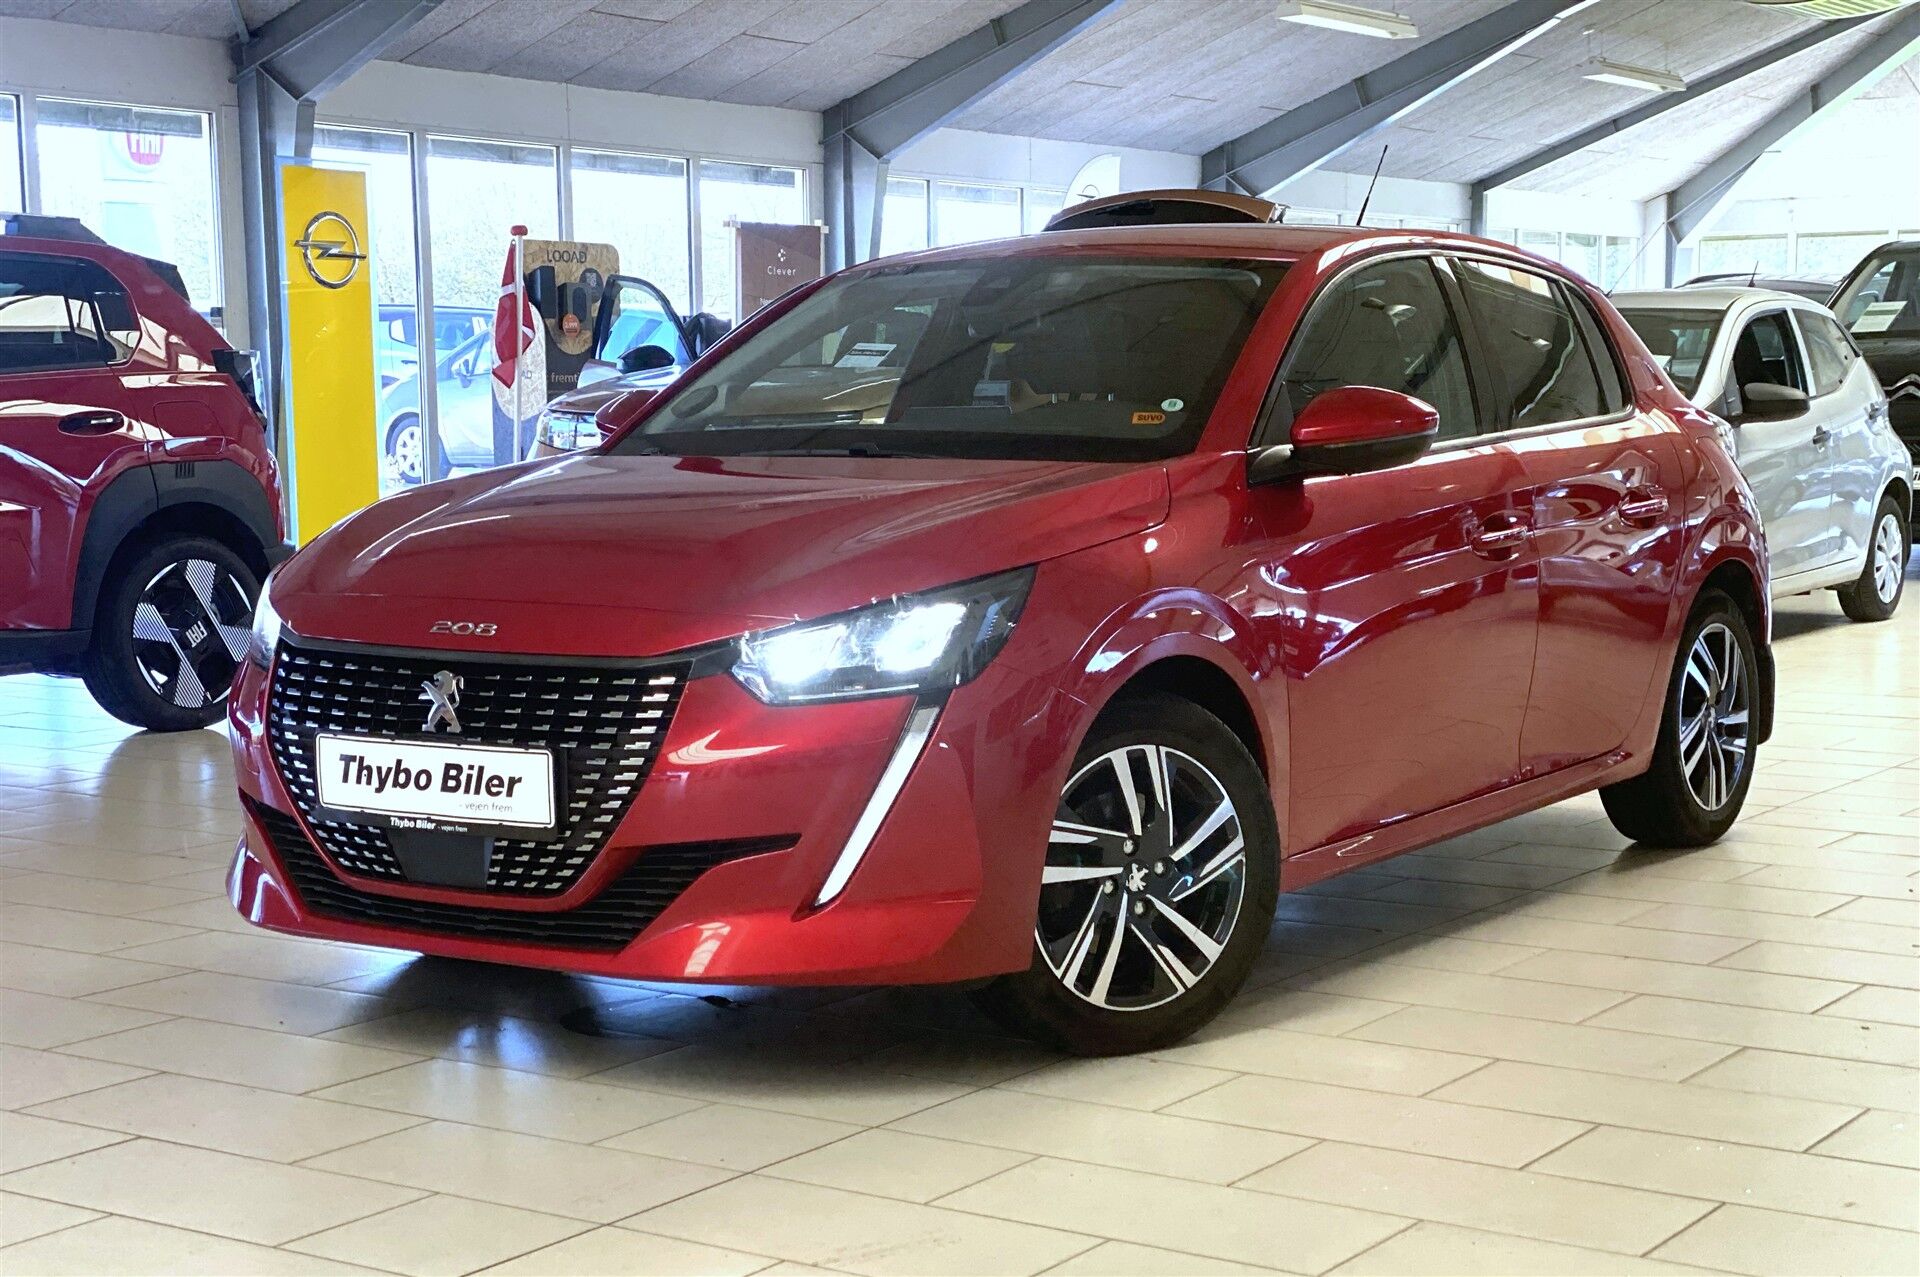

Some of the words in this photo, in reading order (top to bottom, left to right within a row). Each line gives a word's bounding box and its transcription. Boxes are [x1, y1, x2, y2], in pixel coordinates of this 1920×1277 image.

[767, 265, 796, 276] Clever
[551, 372, 580, 382] fremt
[185, 620, 208, 648] FIAT
[429, 620, 498, 636] 208
[338, 753, 433, 794] Thybo
[440, 762, 523, 798] Biler
[464, 802, 489, 811] vejen
[491, 802, 513, 812] frem
[390, 816, 415, 829] Thybo
[416, 819, 437, 830] Biler
